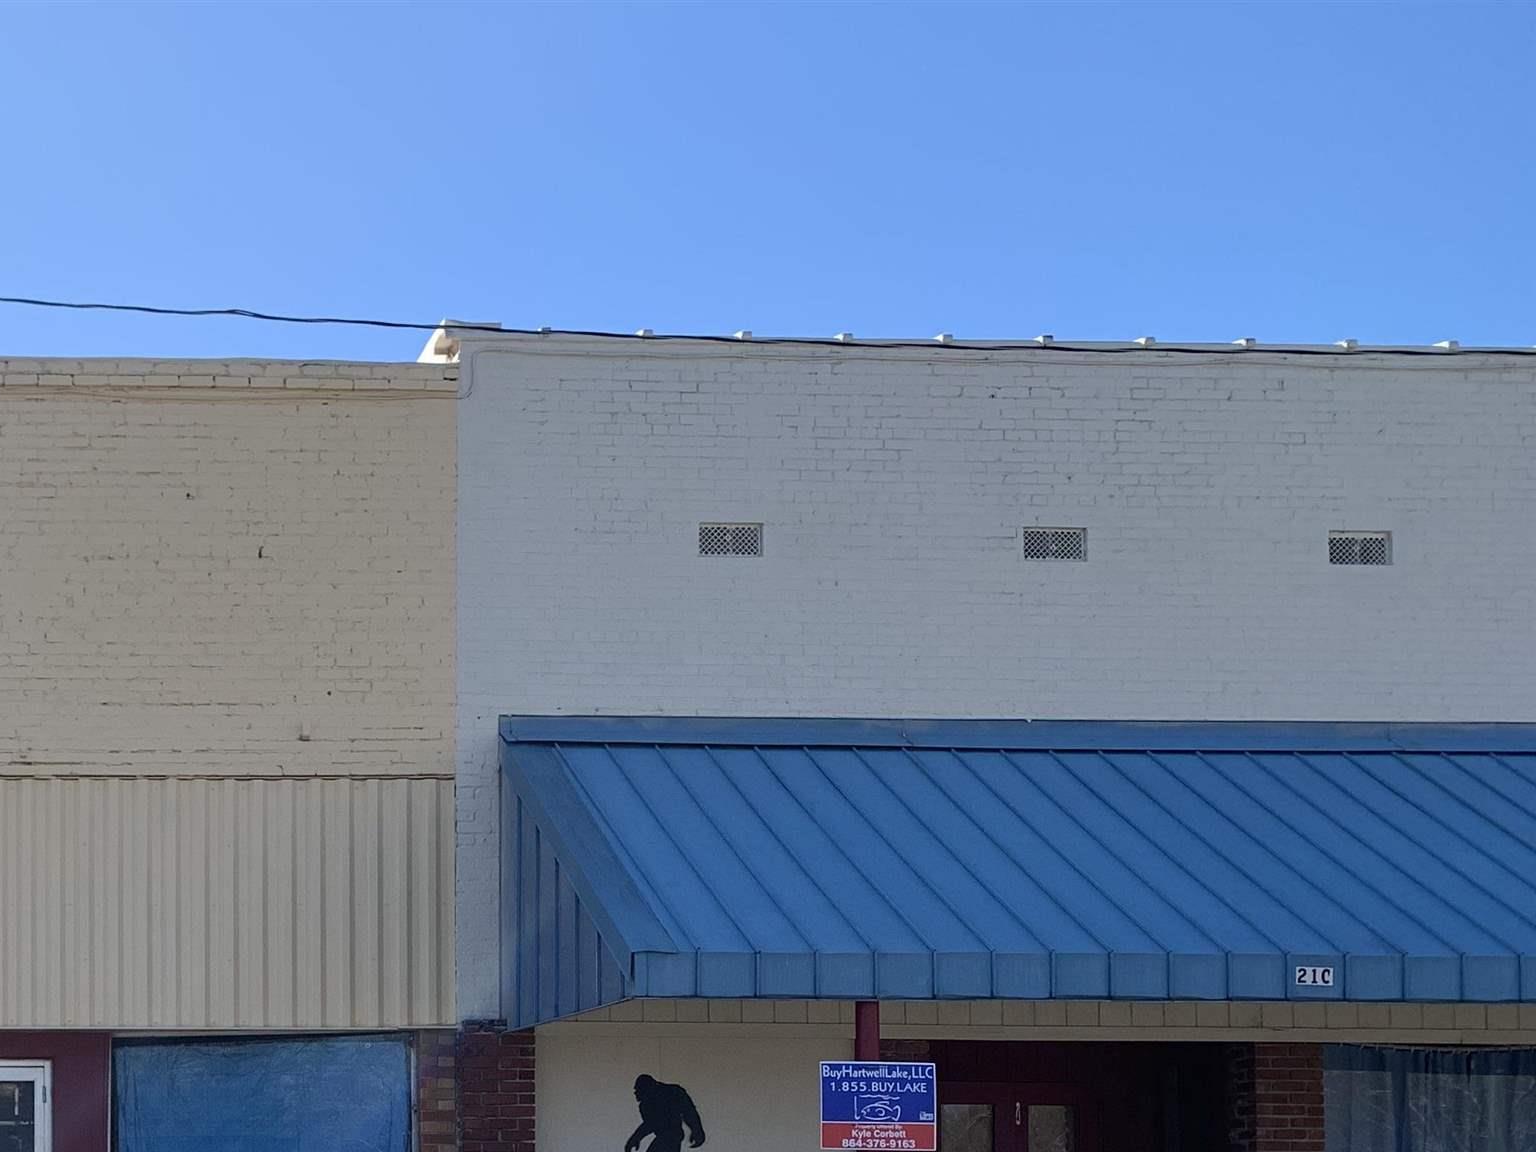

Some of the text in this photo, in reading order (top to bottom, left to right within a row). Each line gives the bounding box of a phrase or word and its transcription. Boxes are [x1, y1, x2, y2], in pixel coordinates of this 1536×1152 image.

[822, 1065, 933, 1080] BuyHartwellLake,LLC
[830, 1082, 928, 1093] 1.855.BUY.LAKE
[851, 1129, 906, 1139] Kyle Corbett
[842, 1139, 916, 1149] 864-376-9163
